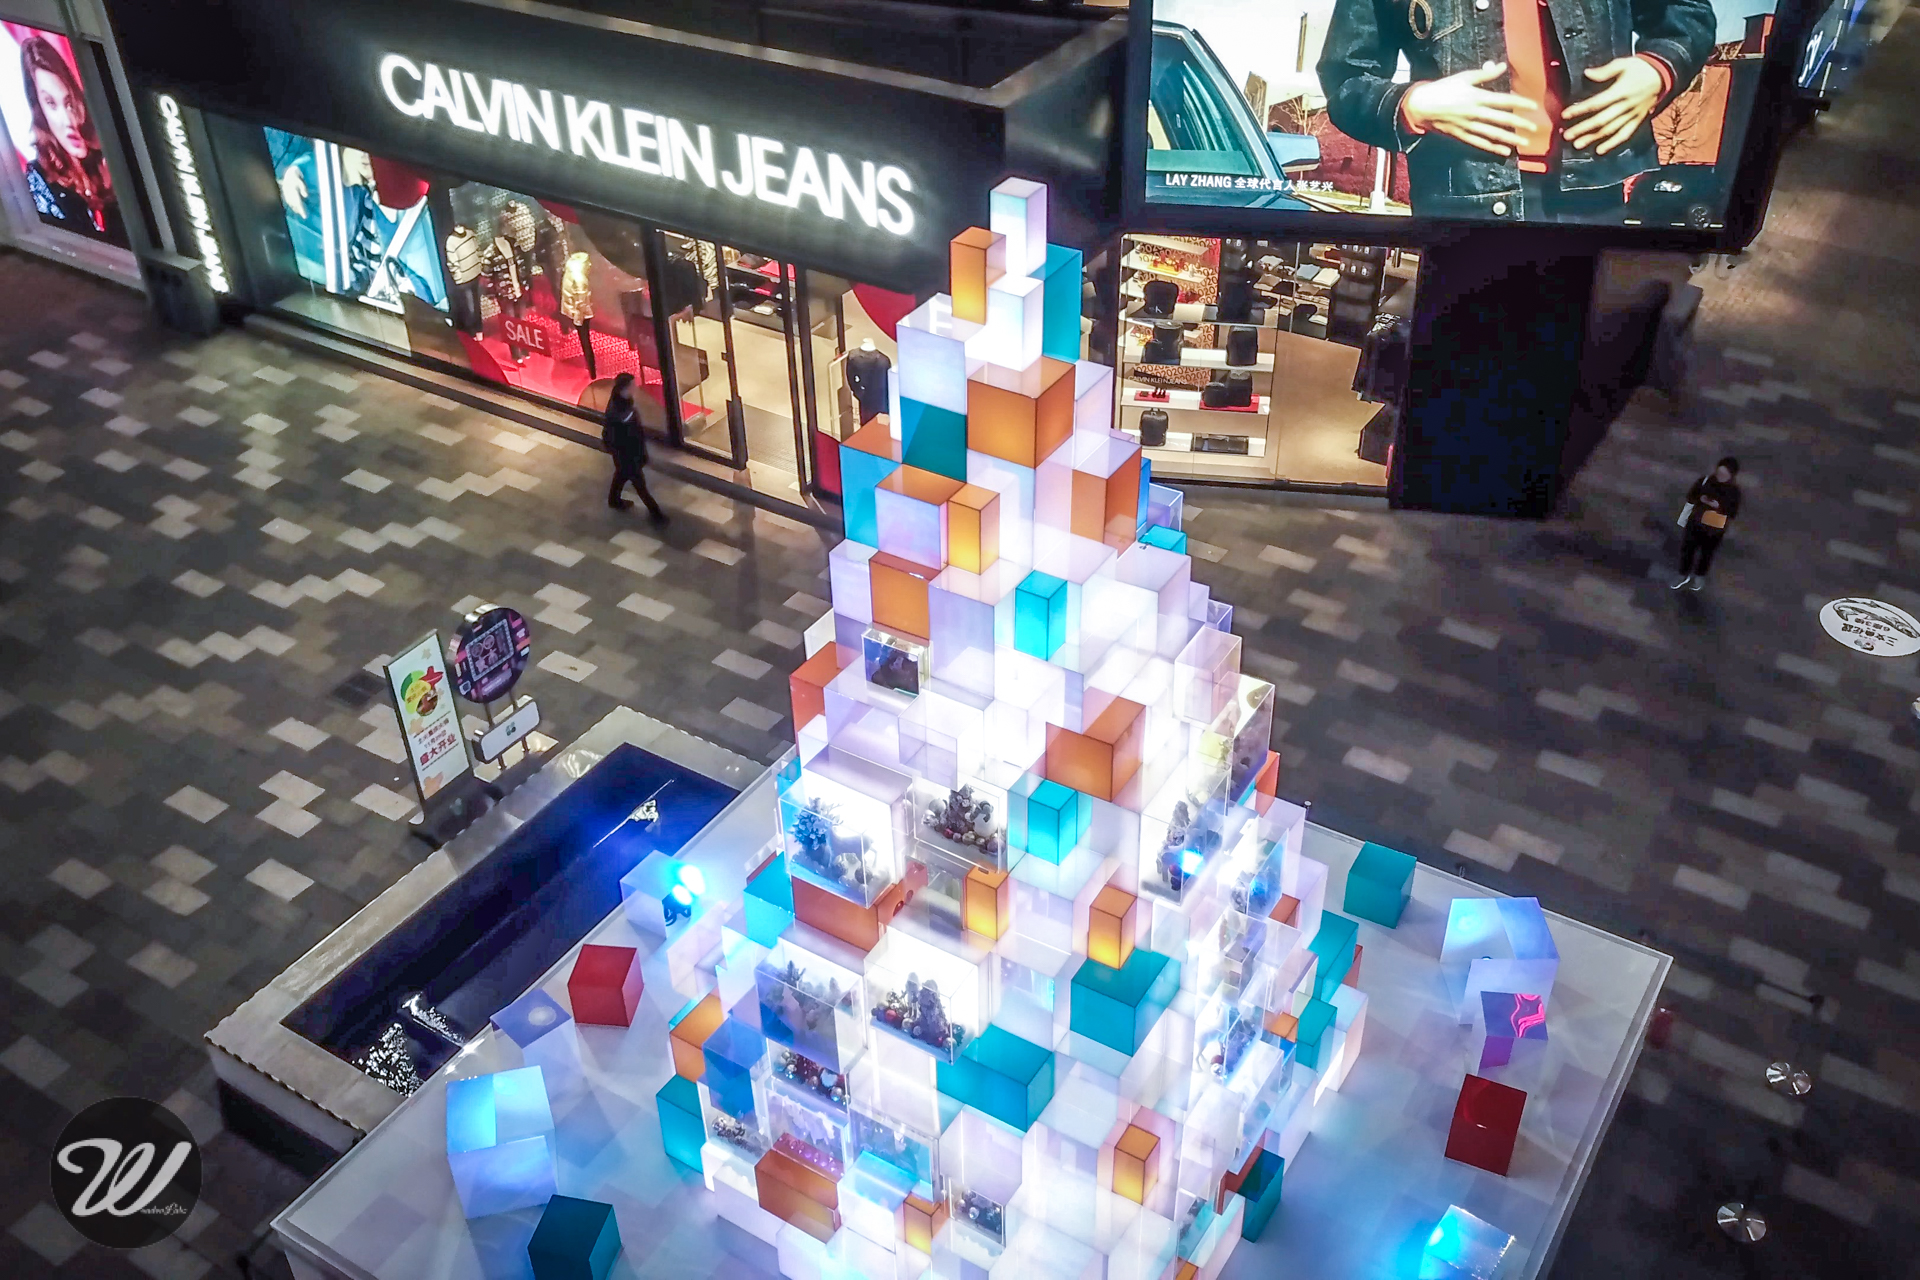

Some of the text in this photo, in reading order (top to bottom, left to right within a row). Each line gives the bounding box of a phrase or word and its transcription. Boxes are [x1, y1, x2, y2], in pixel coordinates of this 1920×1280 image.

[380, 54, 915, 236] CALVIN KLEIN JEANS
[1165, 173, 1188, 187] LAY
[1190, 174, 1232, 189] ZHANG
[505, 320, 544, 350] SALE
